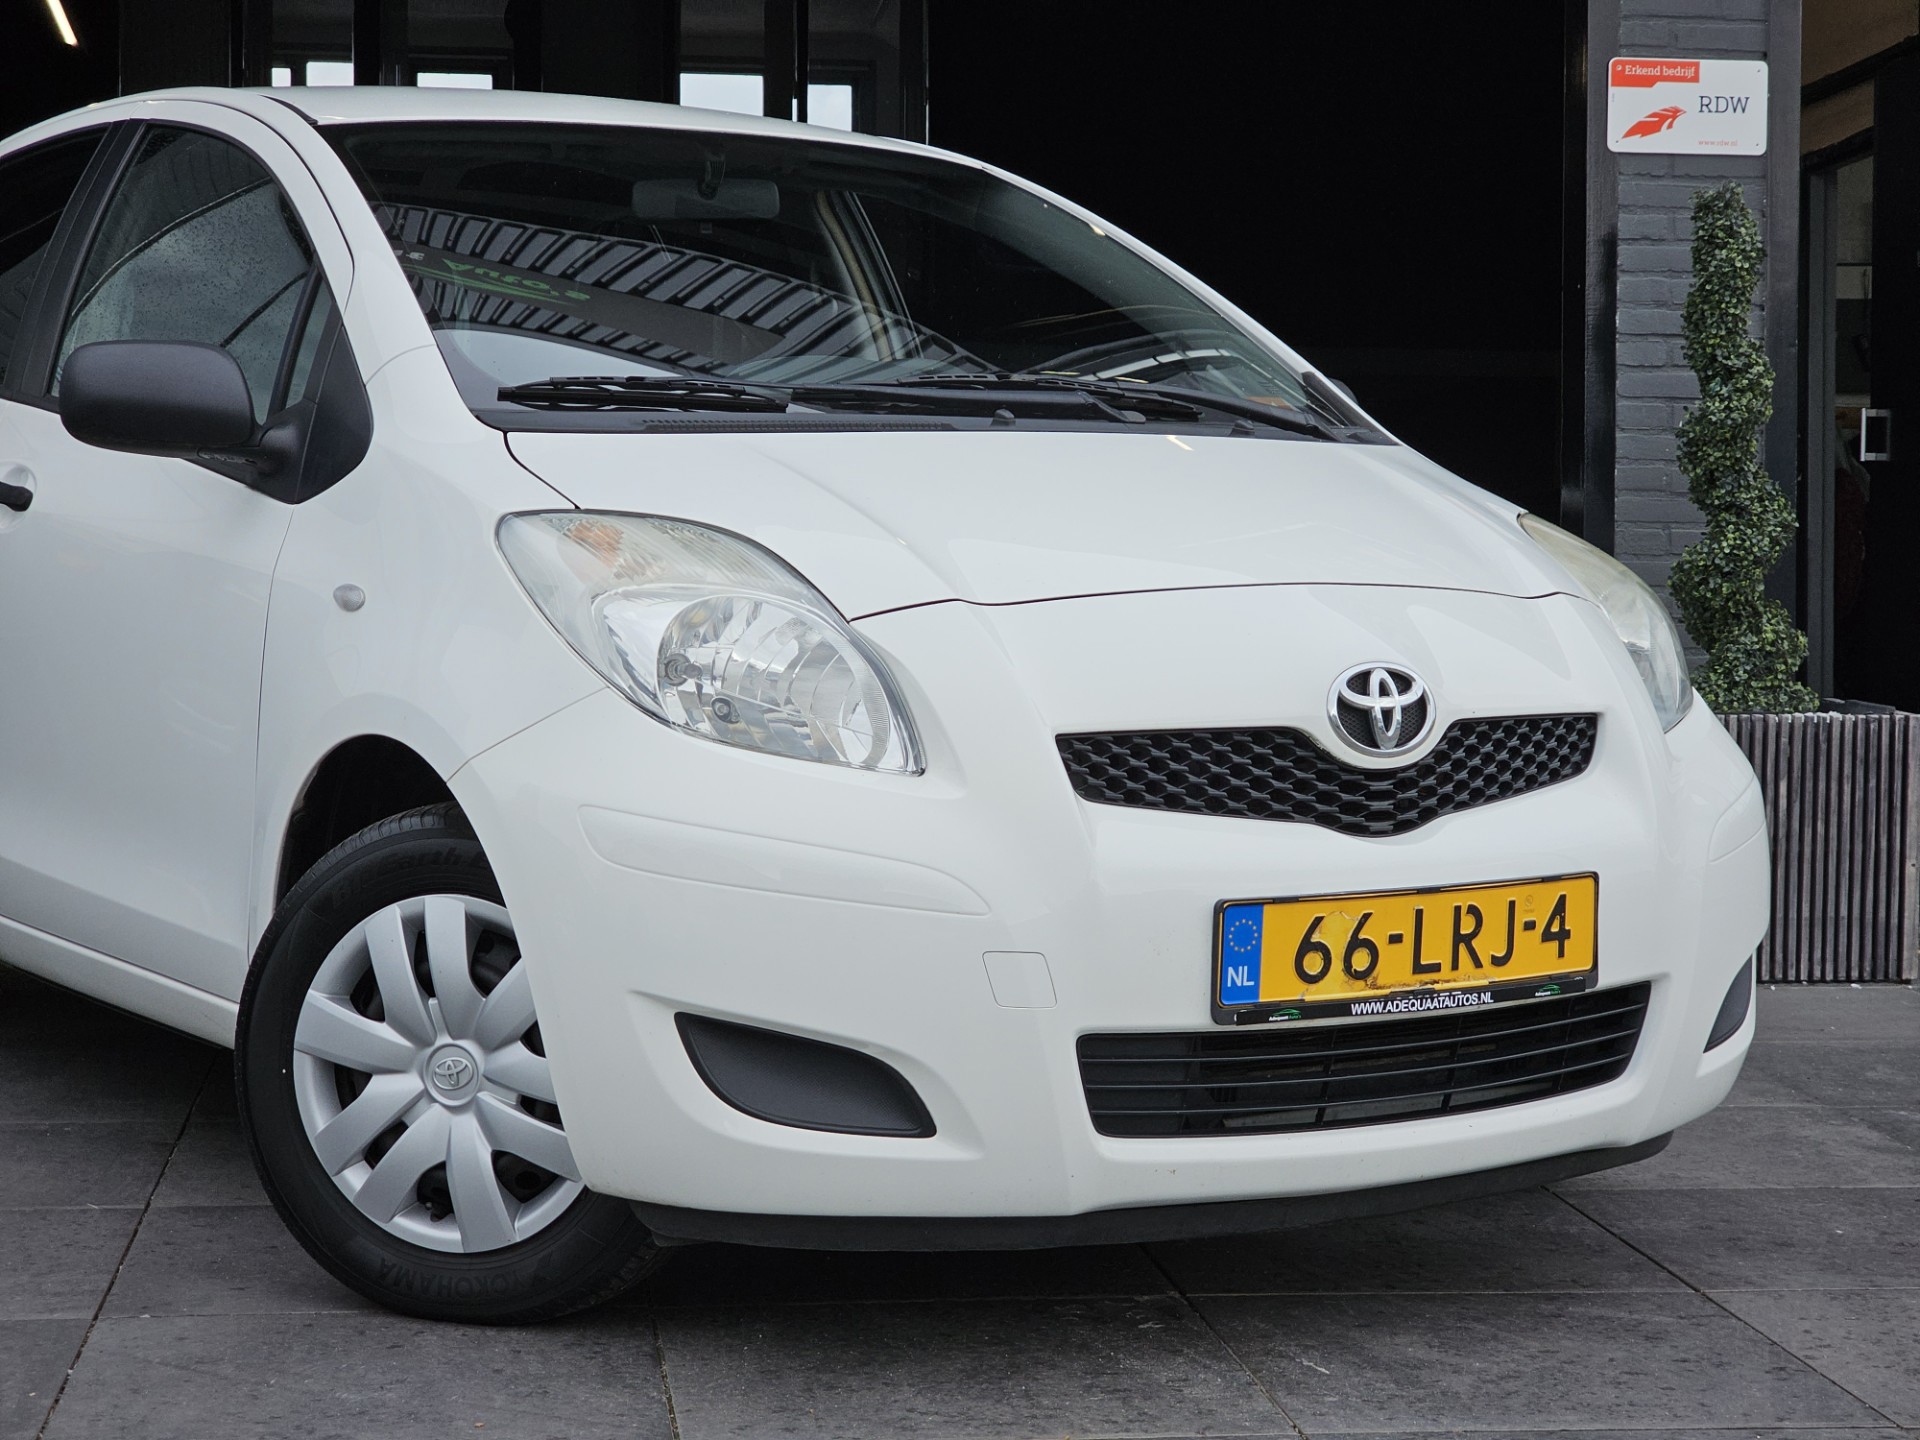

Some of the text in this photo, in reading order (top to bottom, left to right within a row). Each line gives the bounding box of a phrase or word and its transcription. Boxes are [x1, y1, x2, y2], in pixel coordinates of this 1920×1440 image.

[1625, 65, 1695, 79] Erkend bedrijf
[1698, 95, 1750, 114] RDW
[1294, 893, 1571, 985] 66-LRJ-4
[1227, 966, 1254, 988] NL
[1351, 991, 1494, 1016] WWW.ADEQUAATAUTOS.NL
[380, 1257, 527, 1298] YOKOHAMA
